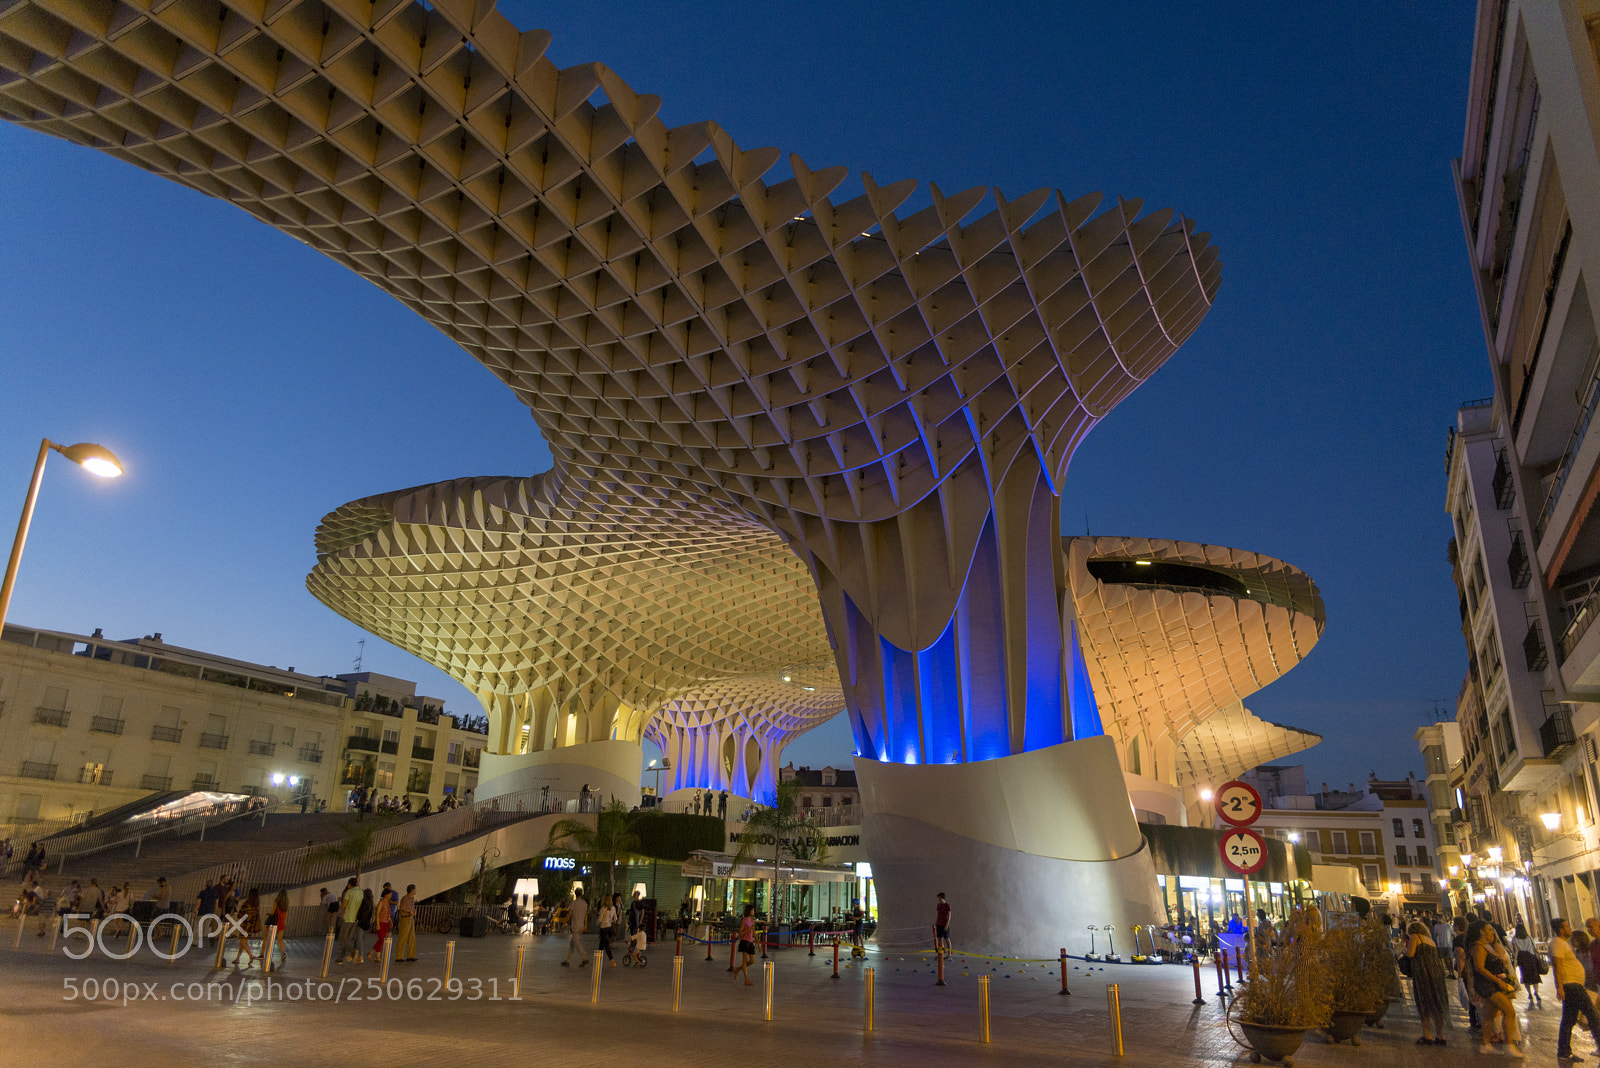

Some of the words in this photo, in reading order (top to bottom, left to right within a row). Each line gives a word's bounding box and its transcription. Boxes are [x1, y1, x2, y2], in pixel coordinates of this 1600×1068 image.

[1231, 845, 1259, 856] 2,5m
[544, 856, 576, 870] moss
[717, 865, 733, 876] BUSH
